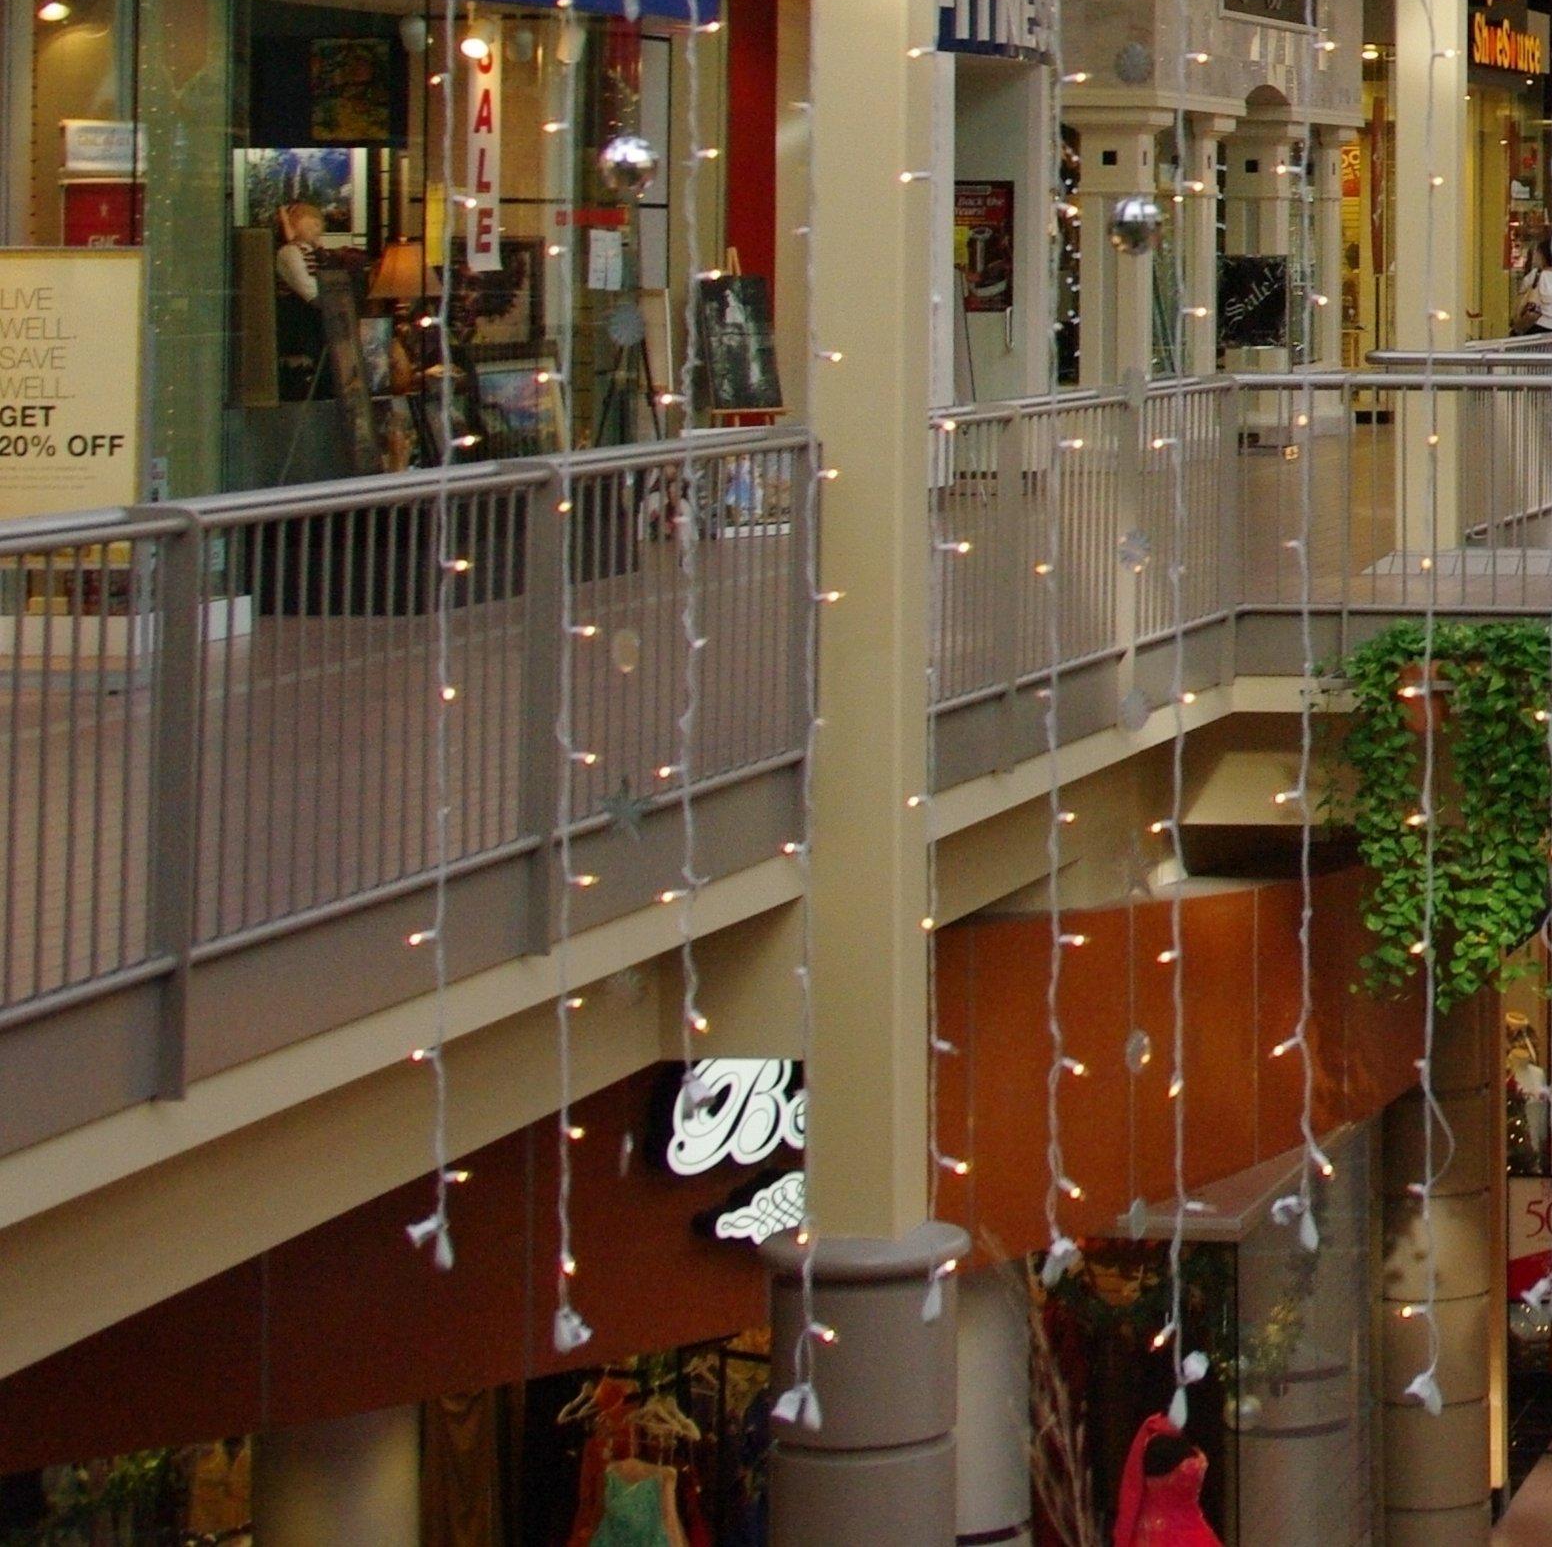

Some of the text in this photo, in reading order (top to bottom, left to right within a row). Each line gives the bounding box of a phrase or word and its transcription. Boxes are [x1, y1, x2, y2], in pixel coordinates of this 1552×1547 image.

[1473, 11, 1542, 75] ShoeSource
[0, 286, 53, 311] LIVE
[0, 346, 66, 371] SAVE
[0, 405, 56, 428] GET
[0, 434, 125, 458] 20% OFF
